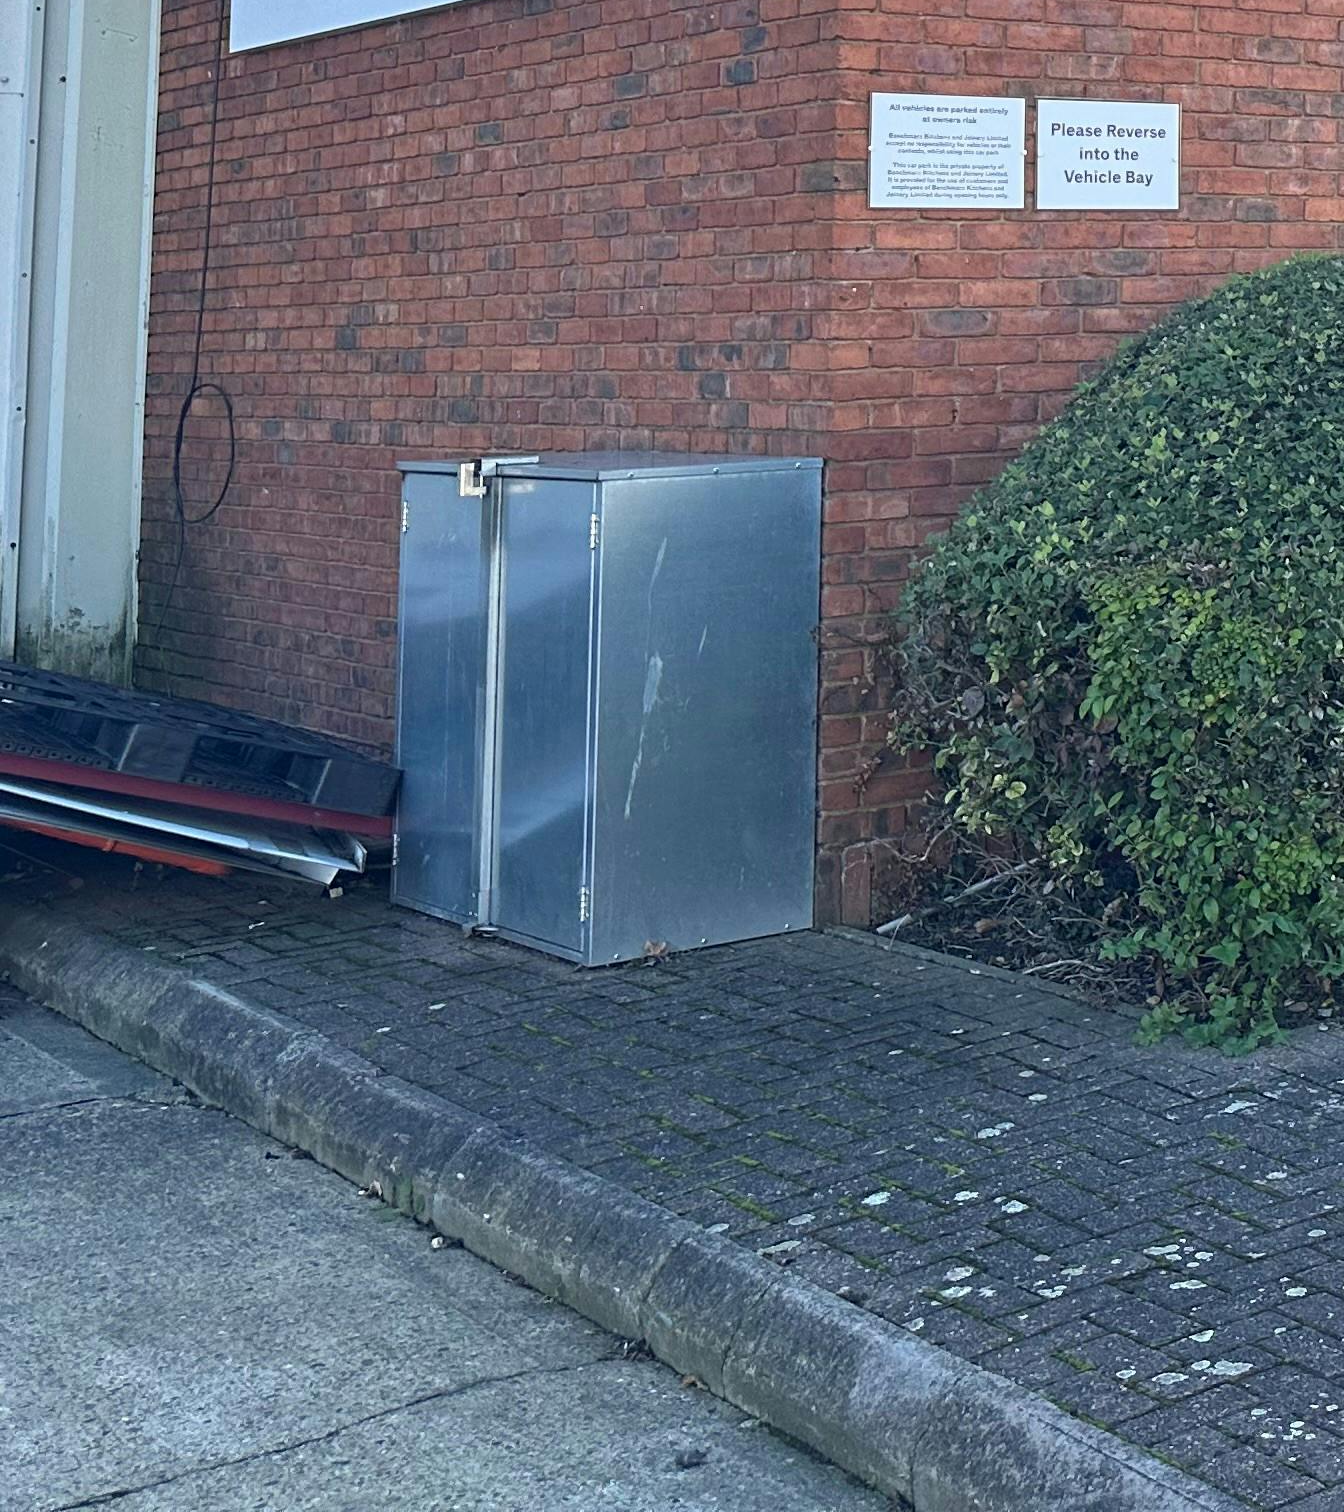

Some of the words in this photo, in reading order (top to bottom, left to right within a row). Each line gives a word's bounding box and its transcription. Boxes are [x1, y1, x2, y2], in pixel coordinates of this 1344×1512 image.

[1051, 123, 1102, 137] Please
[1107, 124, 1166, 139] Reverse
[1079, 147, 1109, 160] into
[1114, 147, 1139, 161] the
[1064, 170, 1121, 183] Vehicle
[1125, 170, 1154, 187] Bay
